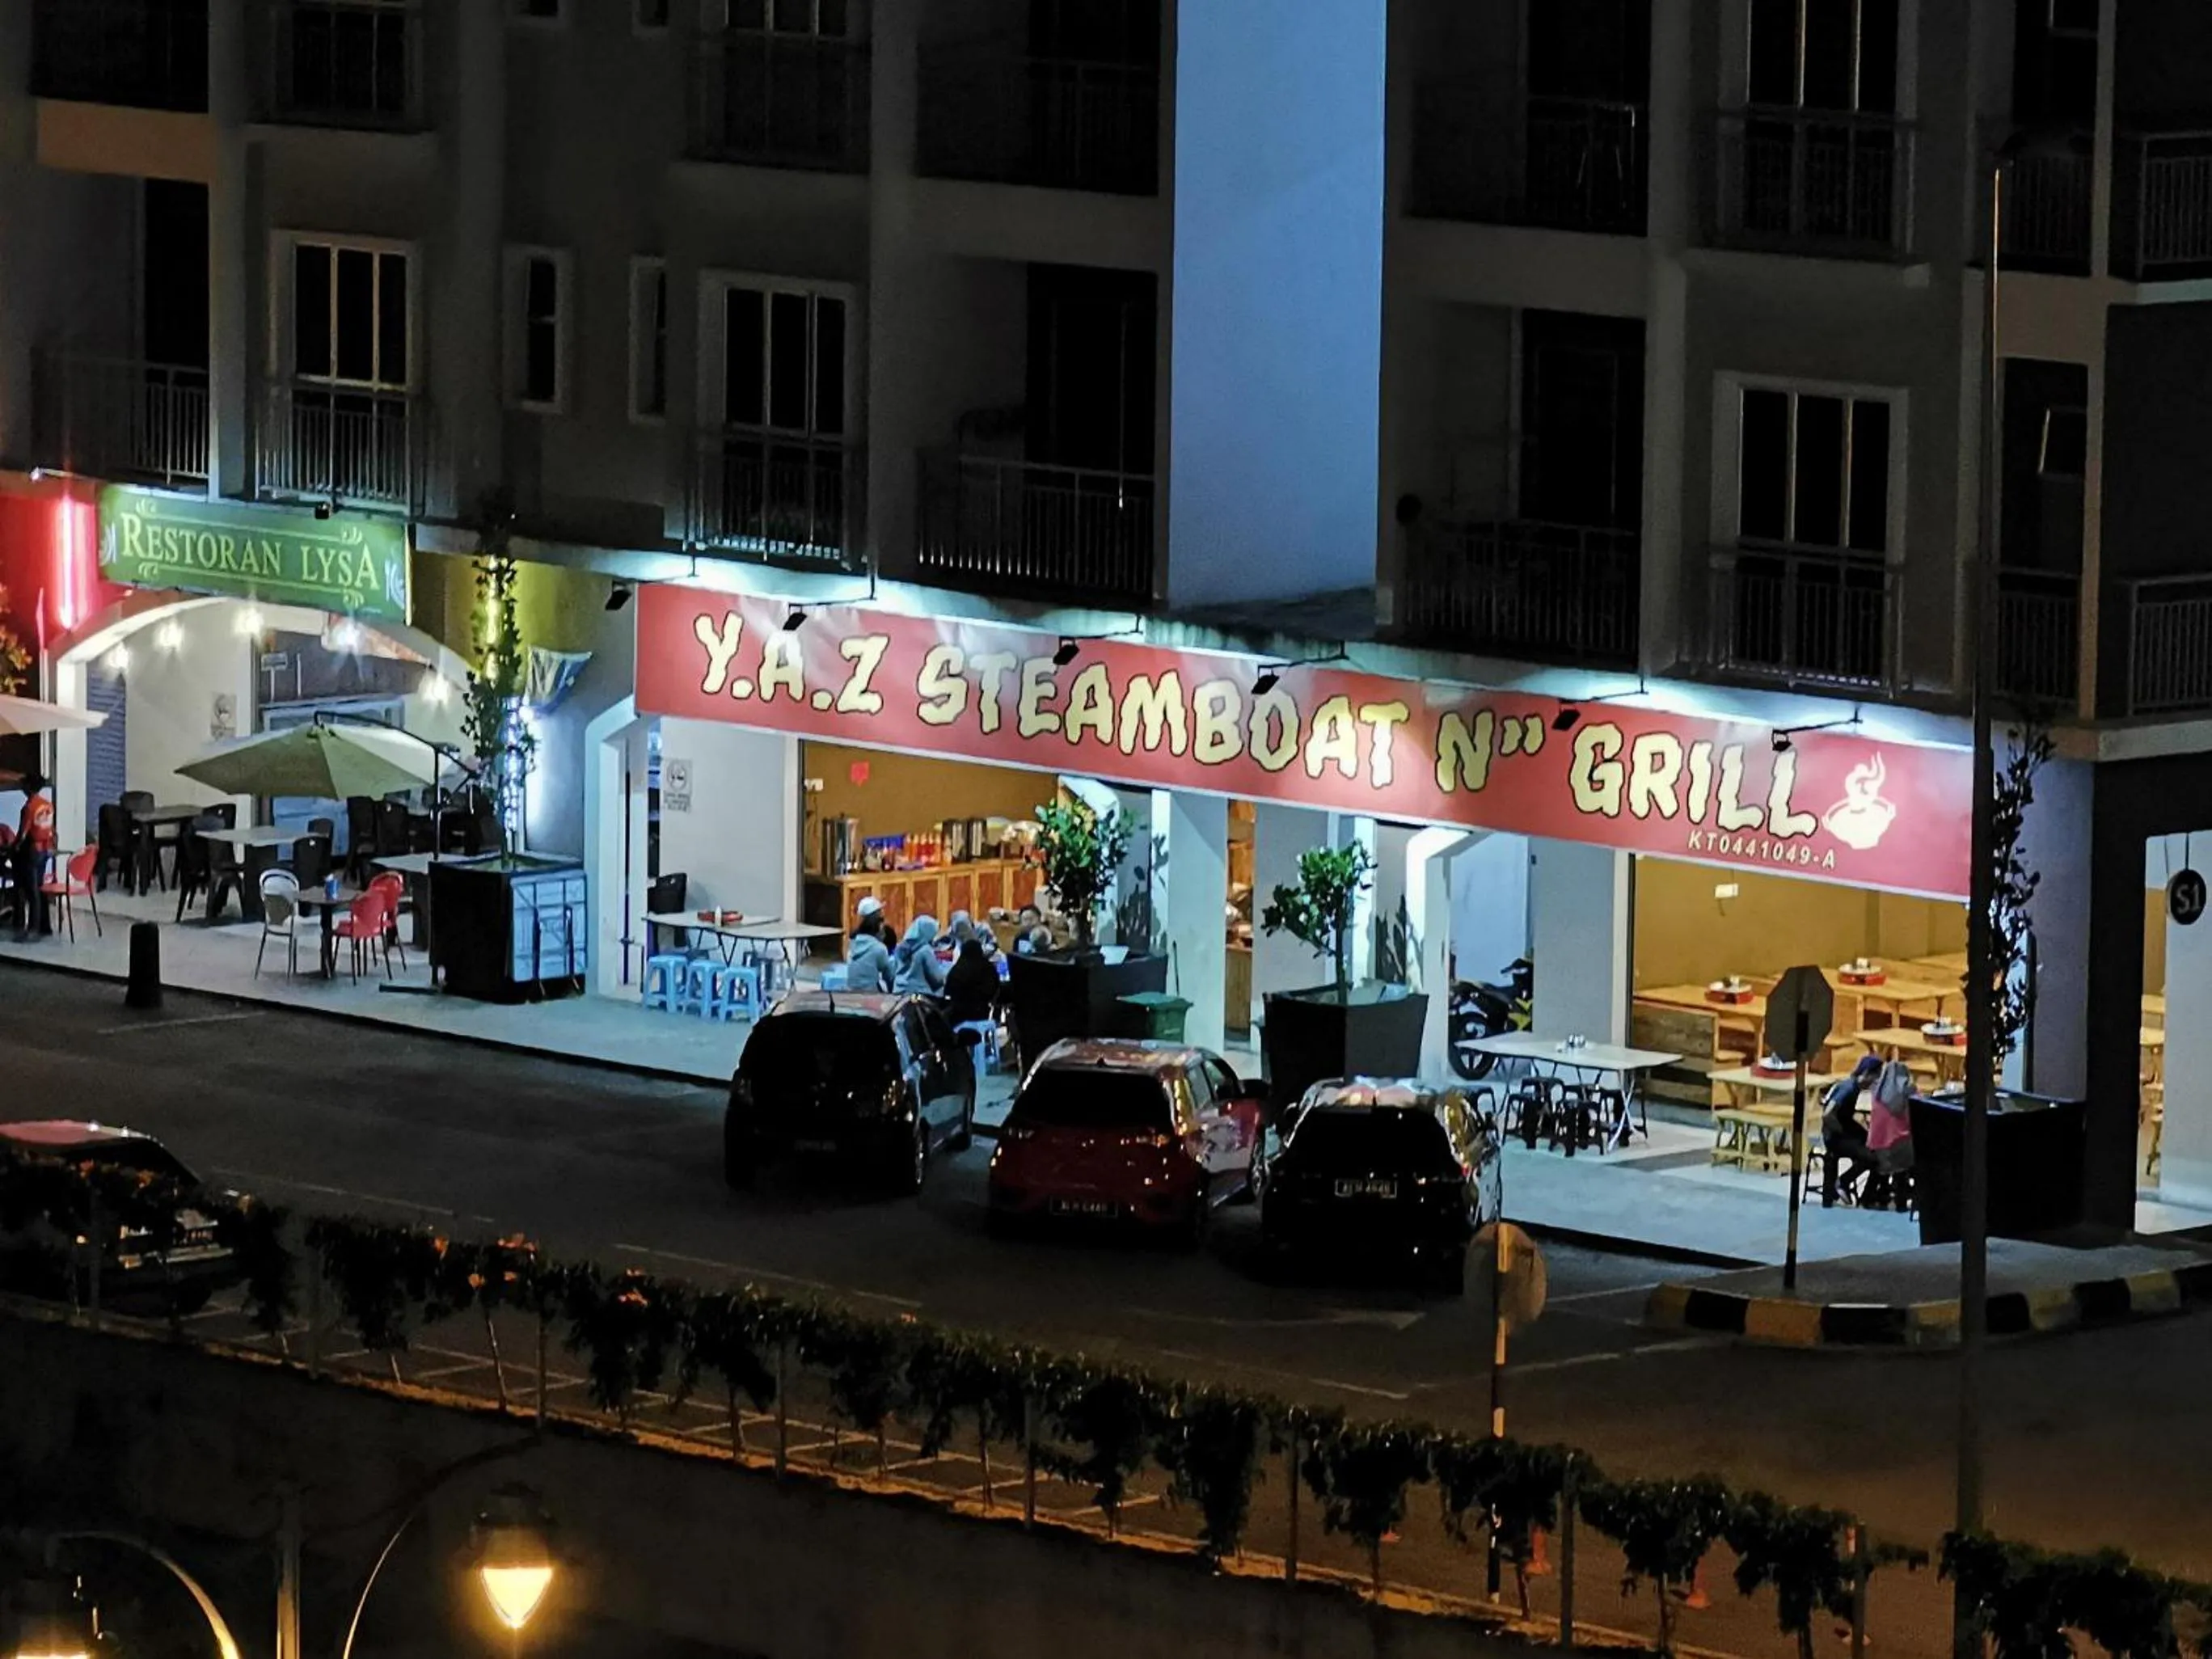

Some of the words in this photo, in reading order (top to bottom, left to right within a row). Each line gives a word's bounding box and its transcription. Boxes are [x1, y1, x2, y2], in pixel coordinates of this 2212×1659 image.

[121, 513, 282, 576] RESTORAN
[300, 542, 379, 589] LYSA
[694, 610, 889, 715] Y.A.Z
[916, 644, 1410, 790] STEAMBOAT
[1567, 722, 1817, 838] GRILL
